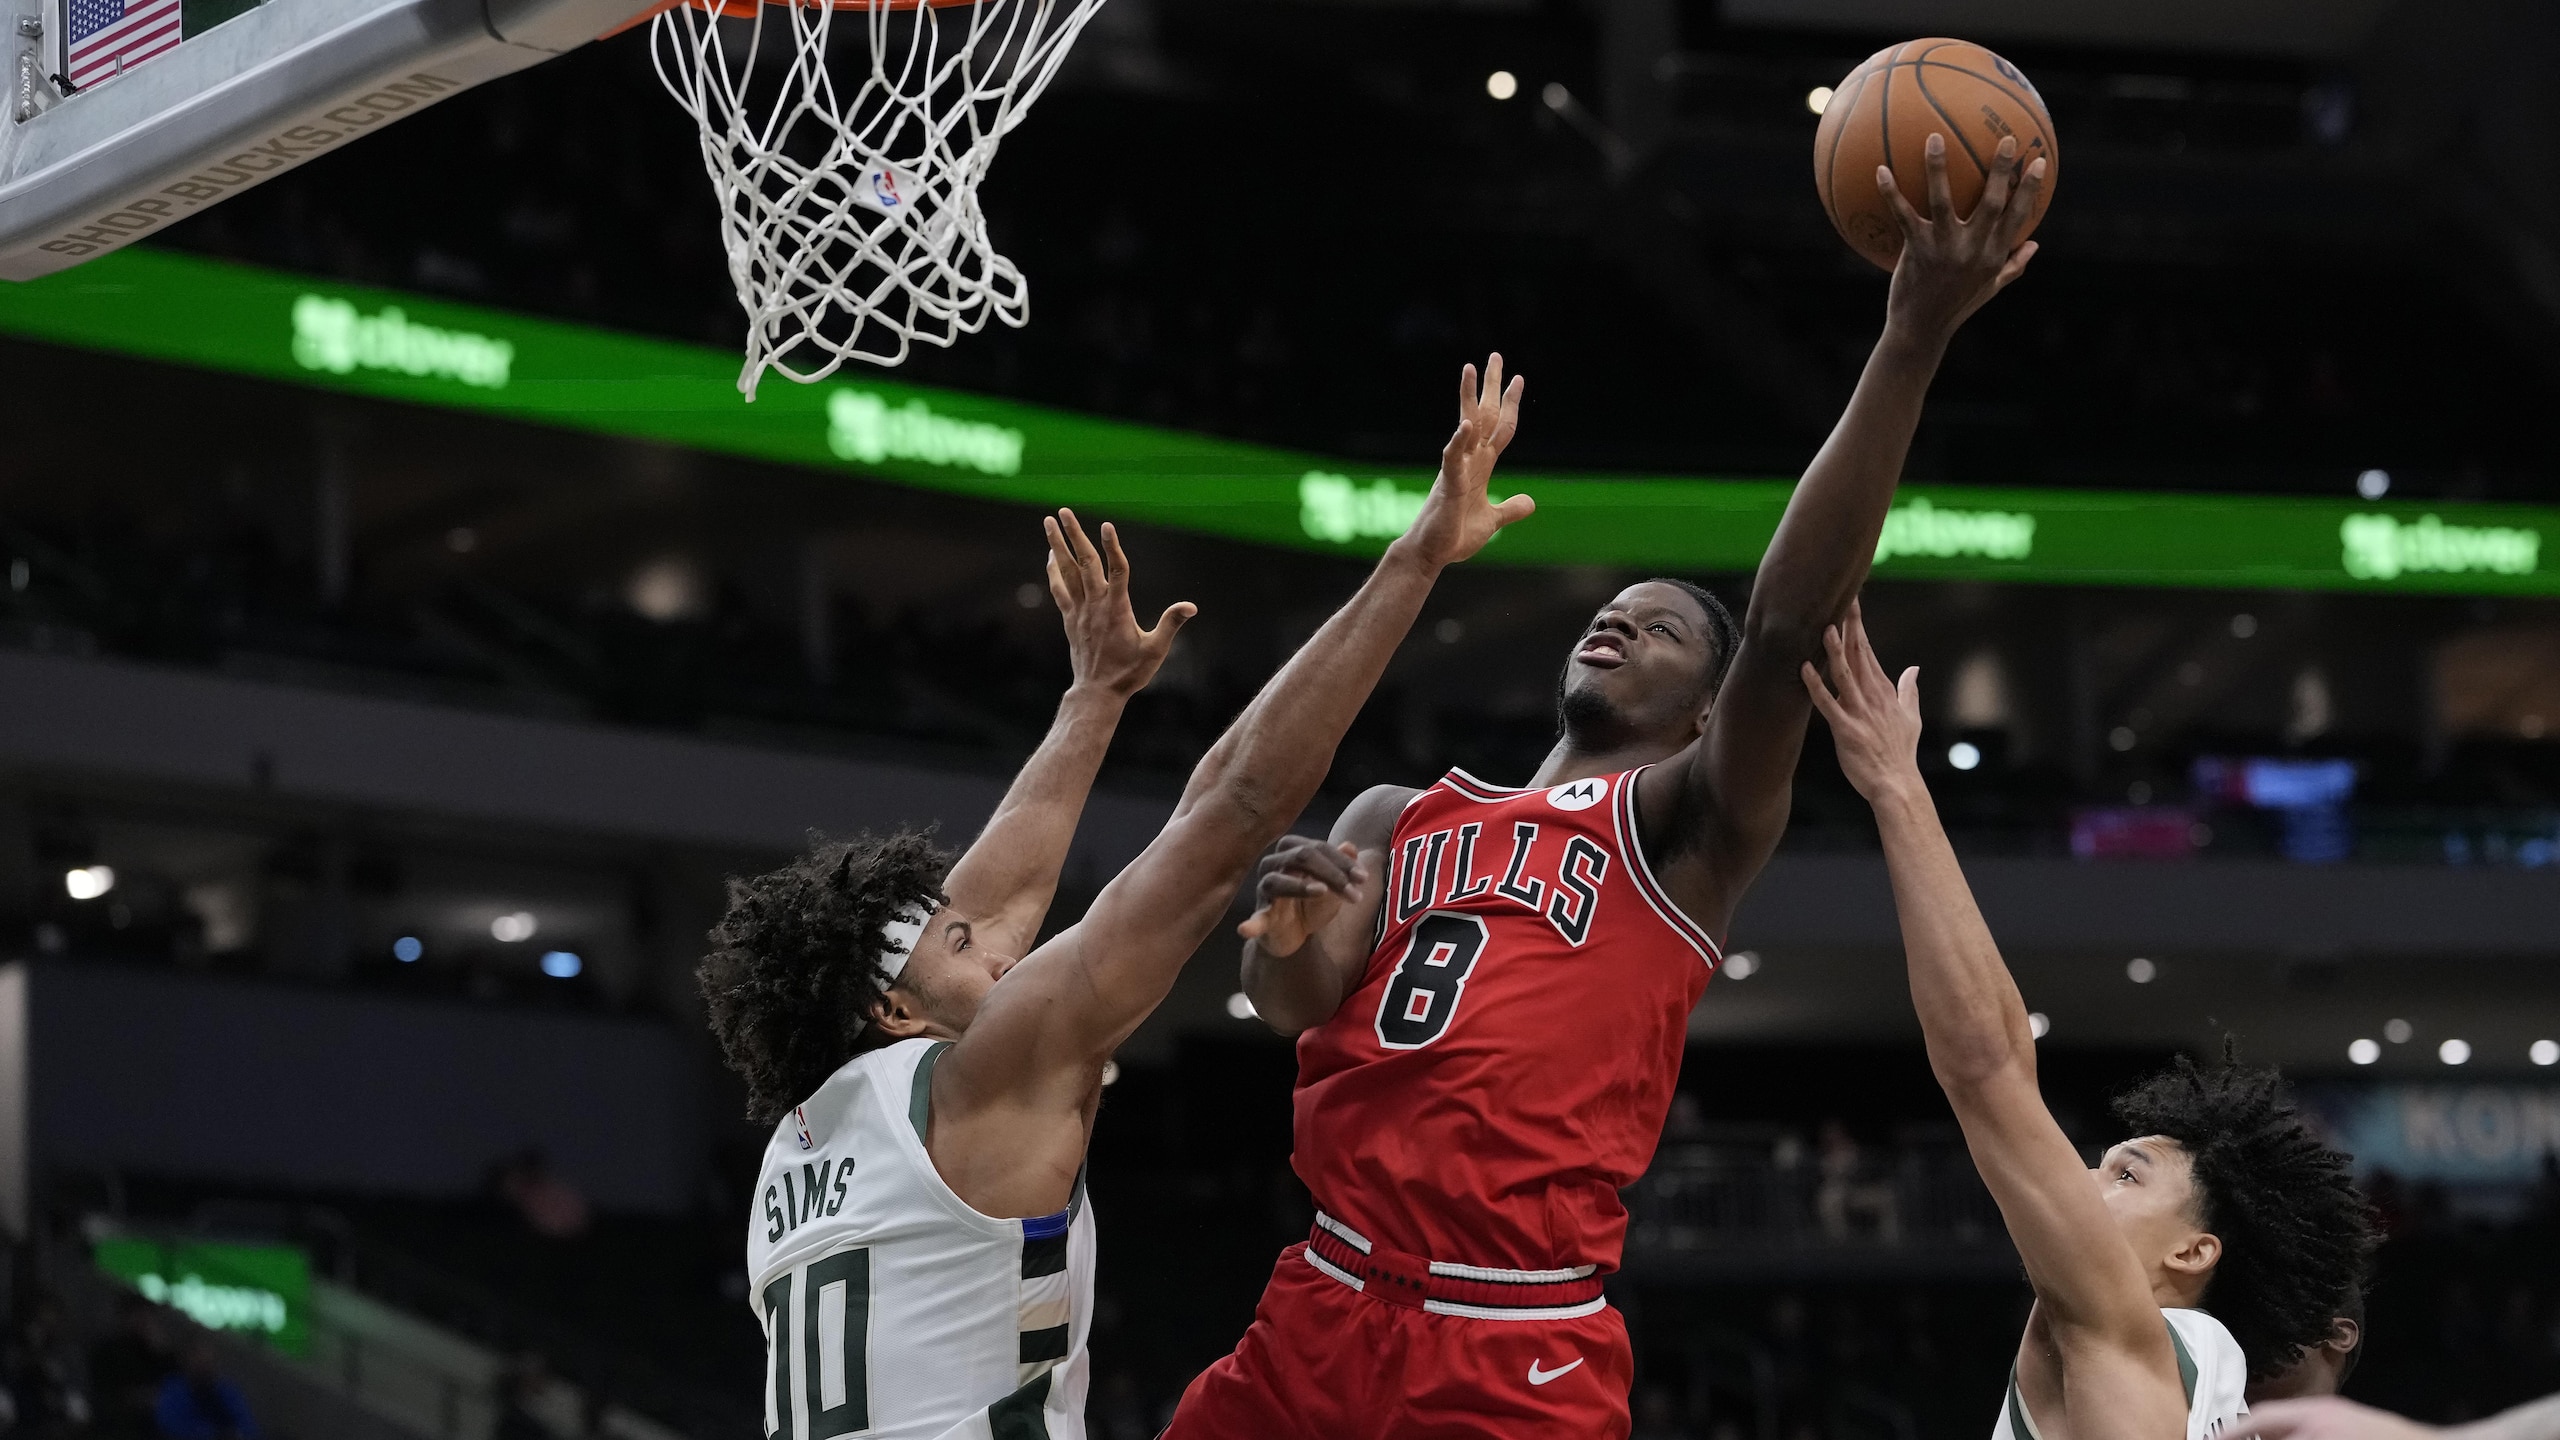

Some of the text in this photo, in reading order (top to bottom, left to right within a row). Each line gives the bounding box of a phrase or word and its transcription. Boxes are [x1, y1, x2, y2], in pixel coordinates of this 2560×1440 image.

[38, 72, 460, 257] SHOP.BUCKS.COM
[1387, 821, 1611, 948] ULLS
[1373, 910, 1490, 1051] 8
[764, 1157, 855, 1243] SIMS
